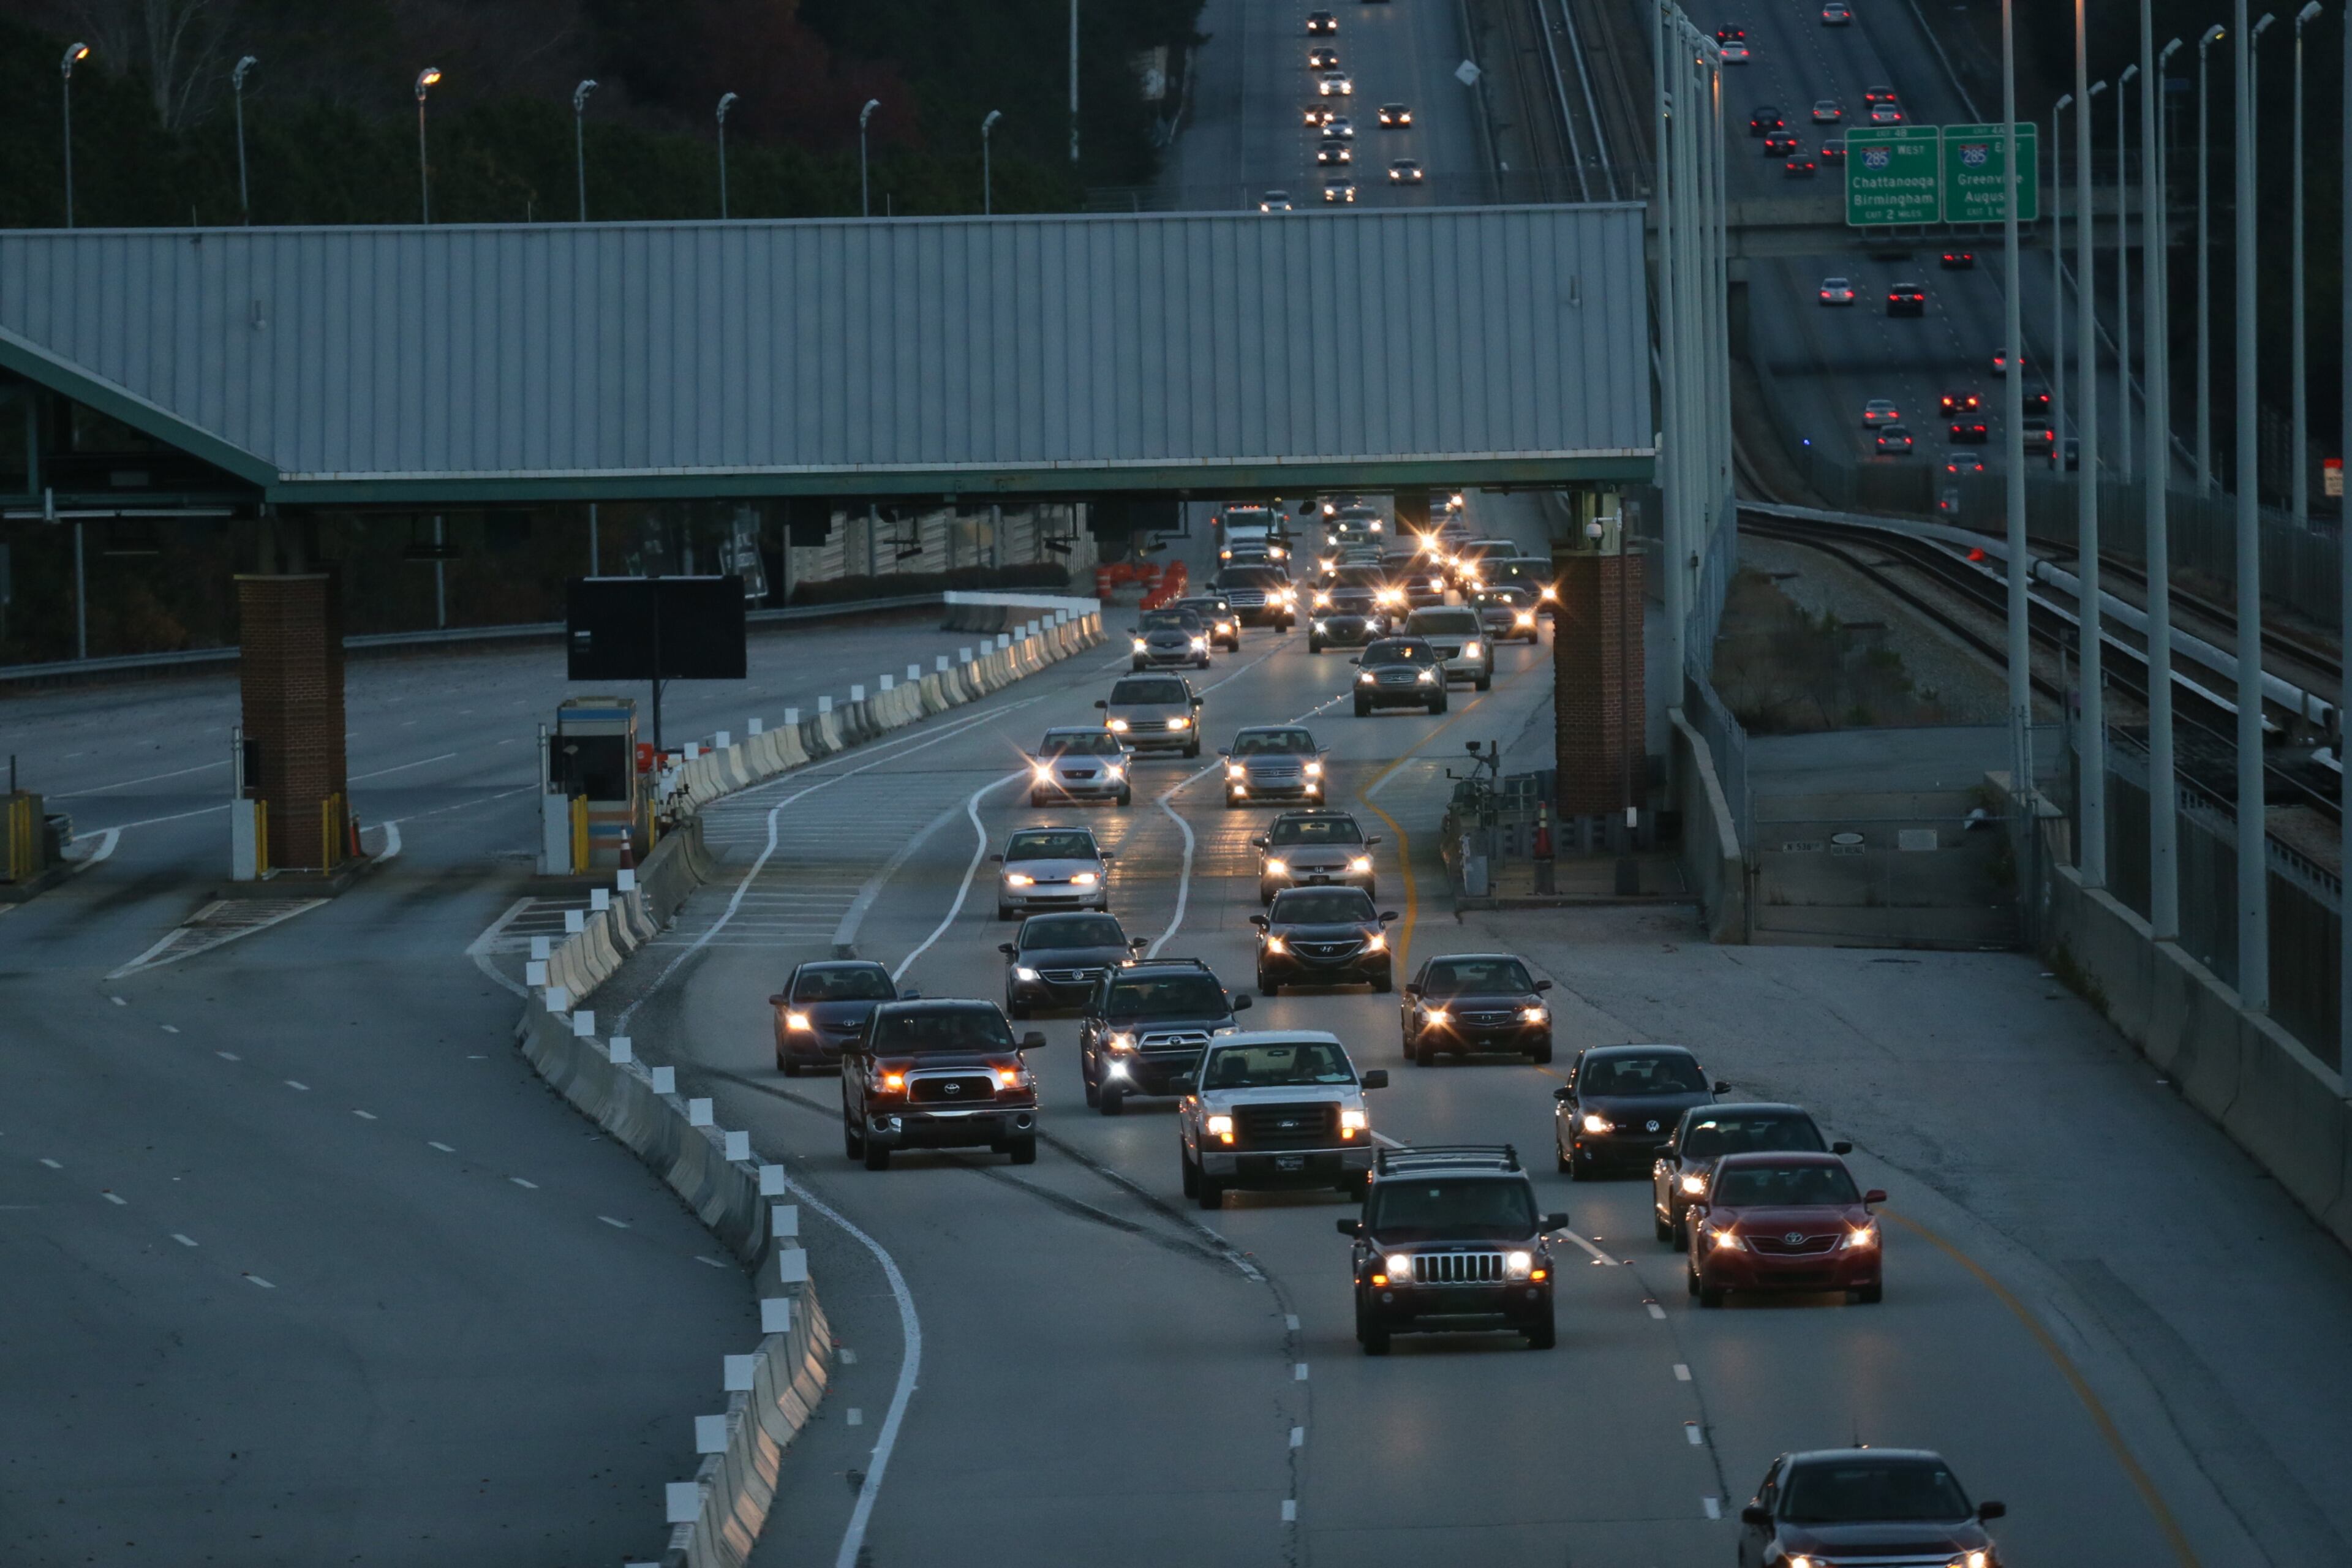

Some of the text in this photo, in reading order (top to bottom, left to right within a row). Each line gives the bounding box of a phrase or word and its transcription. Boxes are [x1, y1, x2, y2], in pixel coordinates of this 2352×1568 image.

[1894, 128, 1908, 137] 4B
[1897, 145, 1925, 155] WEST
[1964, 149, 1987, 163] 285
[1866, 151, 1889, 165] 285
[1852, 175, 1935, 189] Chattanooga
[1853, 192, 1936, 208] Birmingham
[1964, 190, 2006, 205] Augus
[1887, 209, 1894, 220] 2
[1988, 206, 1993, 217] 1
